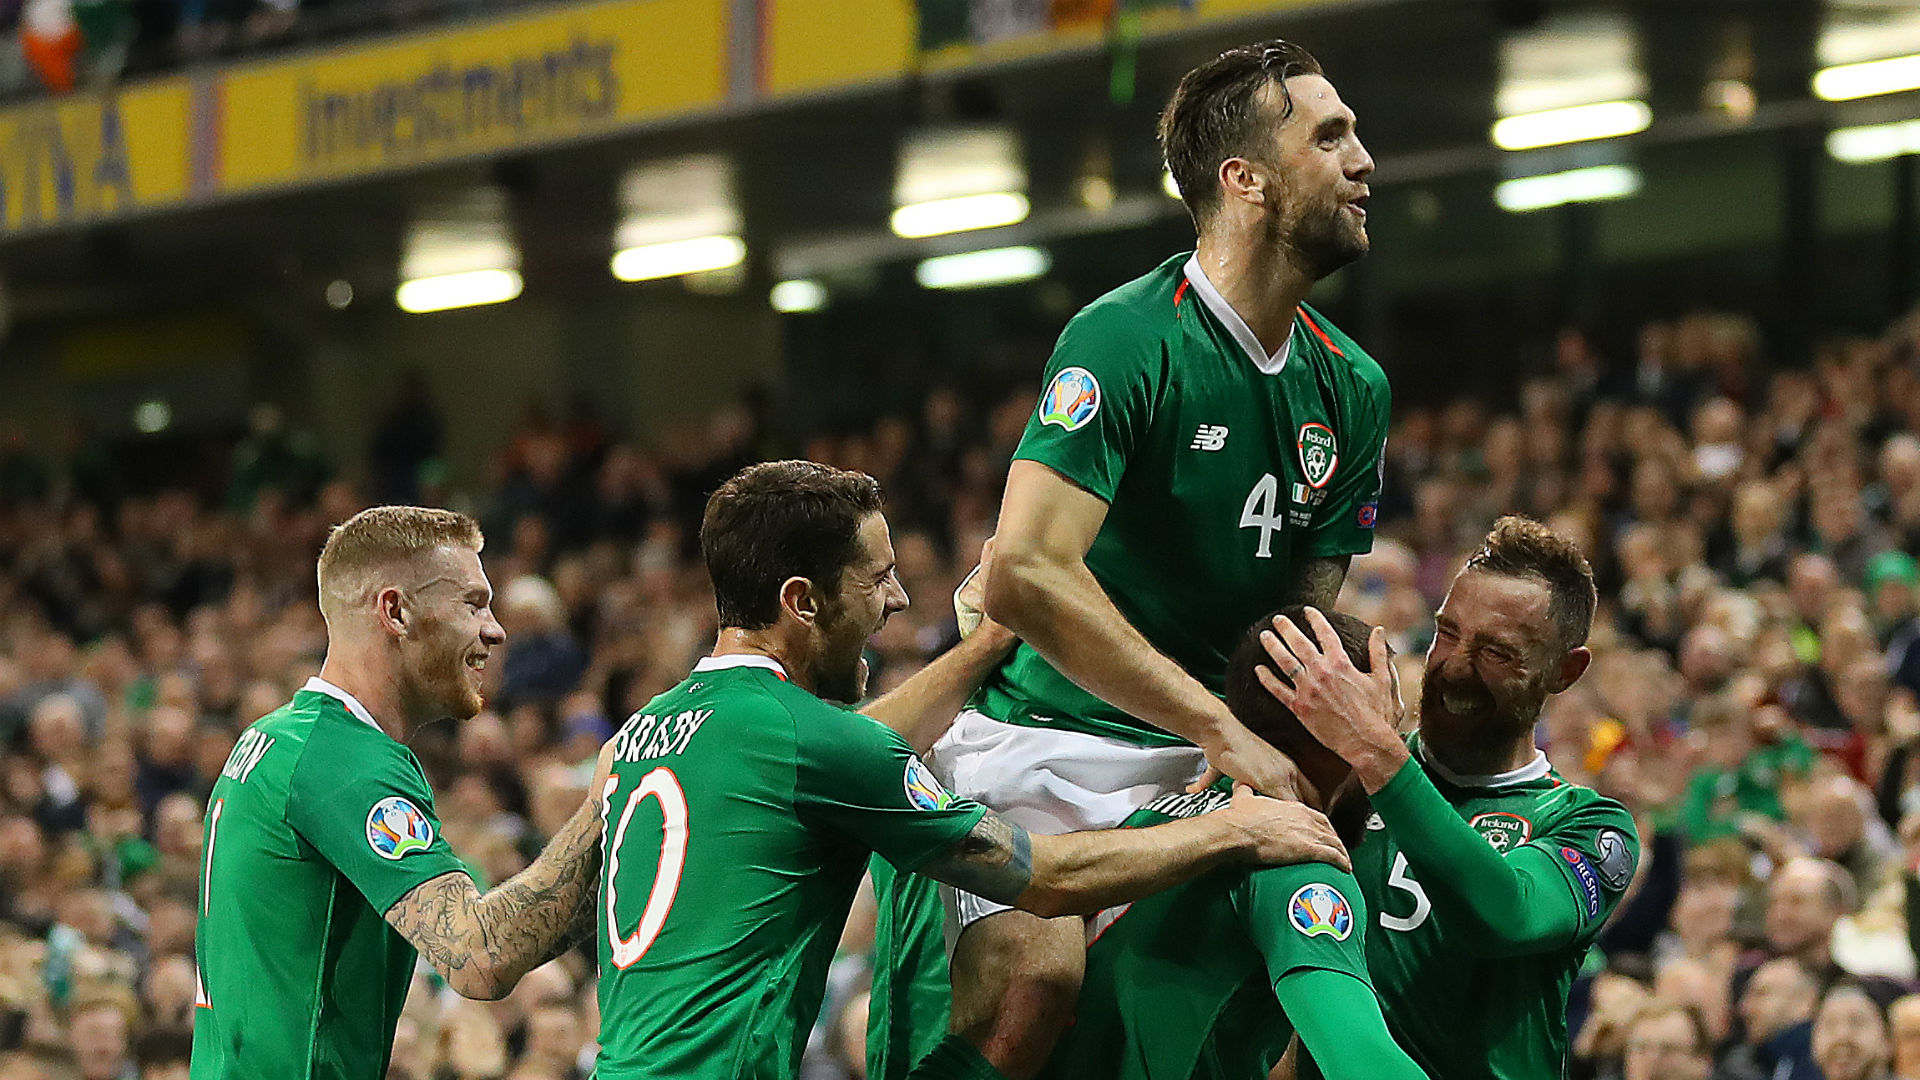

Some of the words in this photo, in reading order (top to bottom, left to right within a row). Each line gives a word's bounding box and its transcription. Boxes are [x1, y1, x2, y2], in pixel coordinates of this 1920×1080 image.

[1306, 430, 1331, 447] Ireland
[1239, 473, 1281, 557] 4
[614, 709, 714, 762] BRADY
[1480, 819, 1519, 831] Ireland
[1380, 851, 1432, 931] 5
